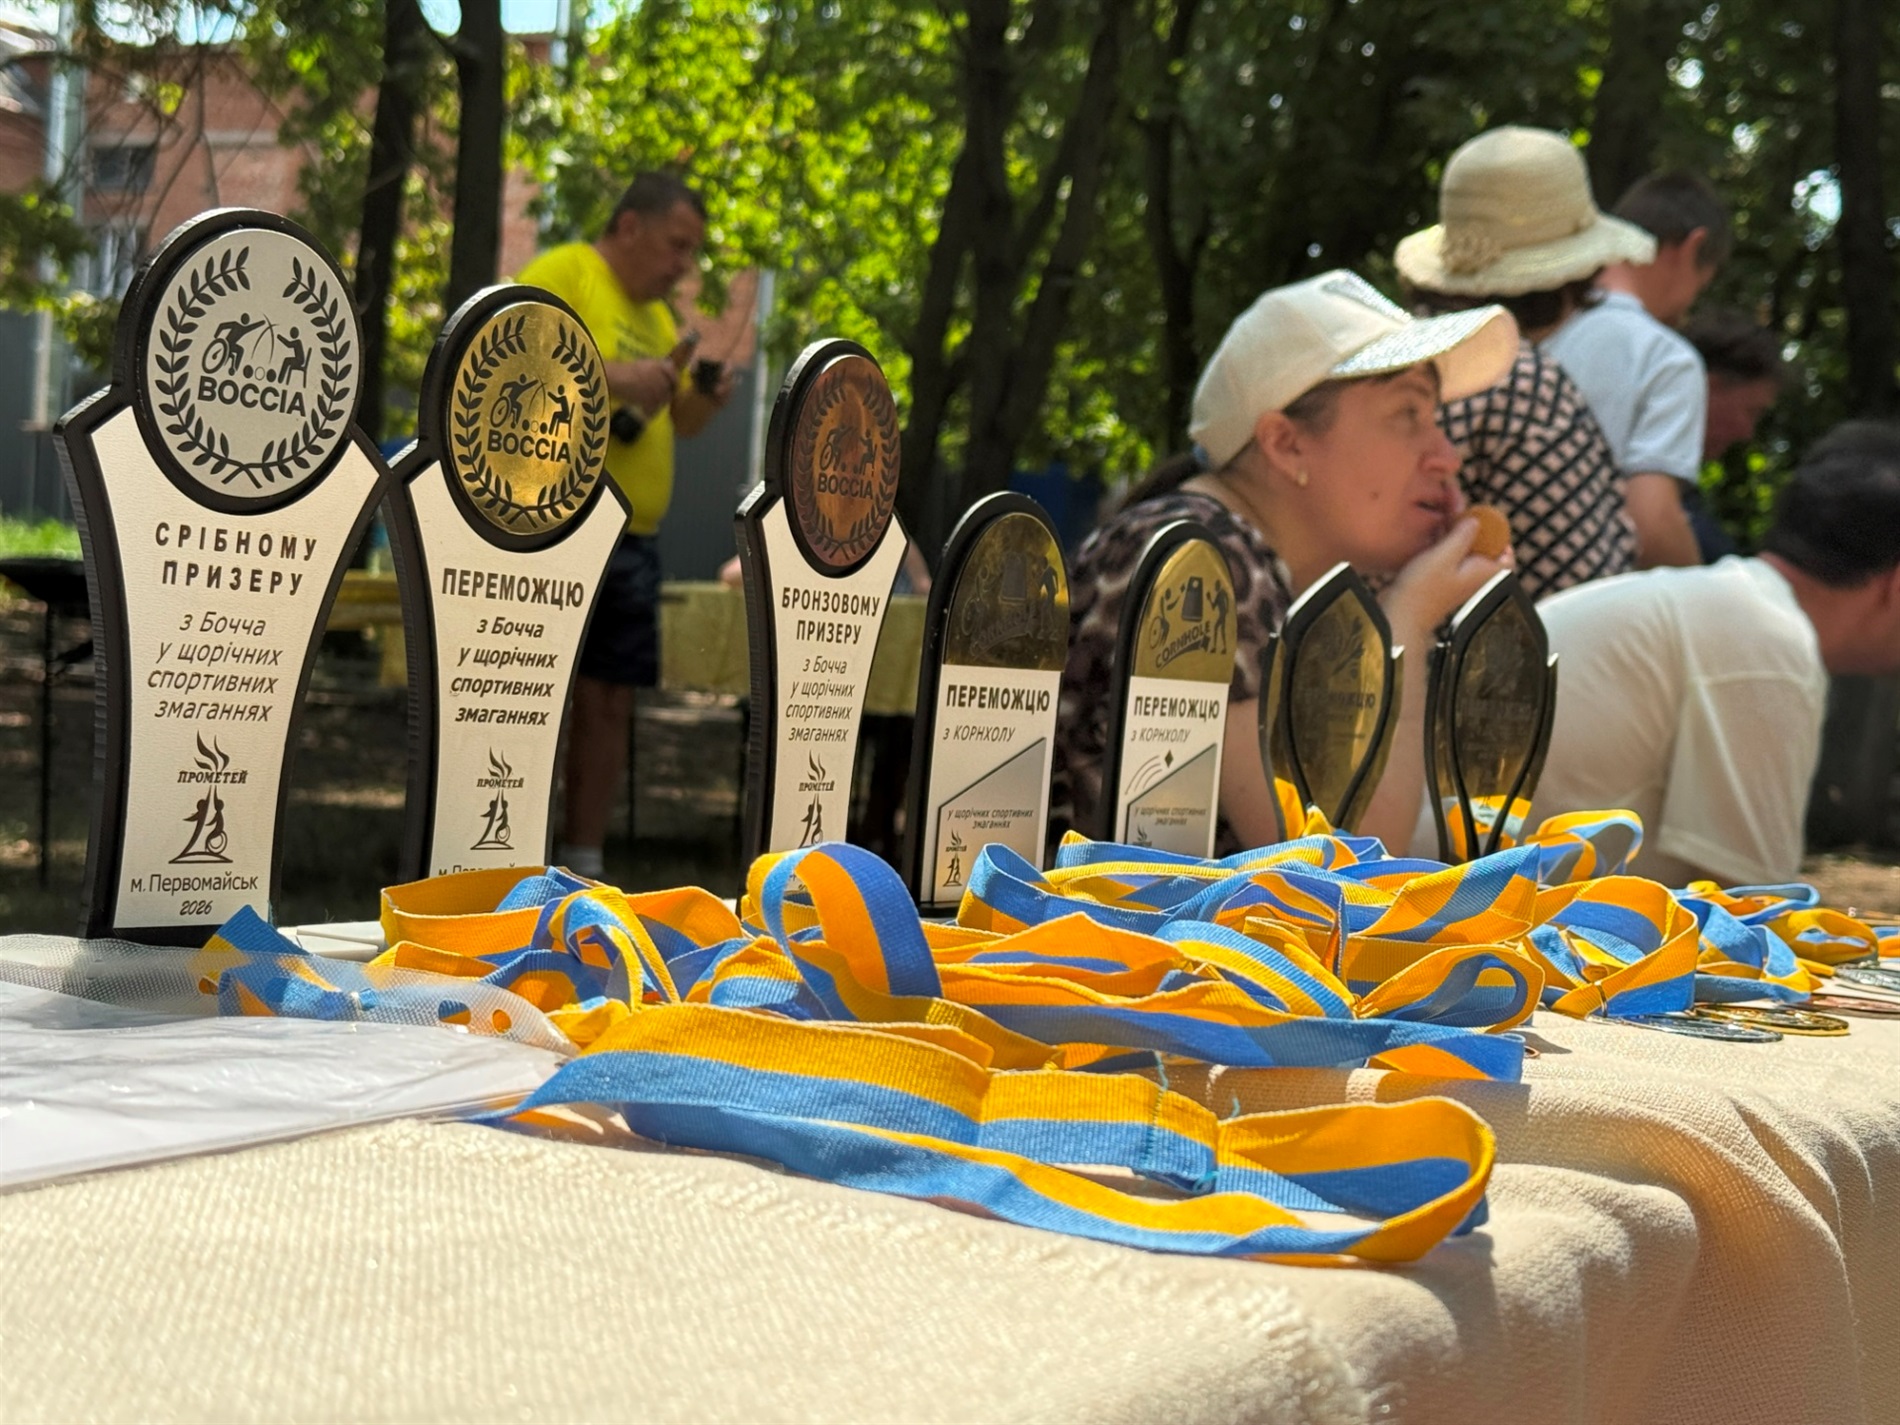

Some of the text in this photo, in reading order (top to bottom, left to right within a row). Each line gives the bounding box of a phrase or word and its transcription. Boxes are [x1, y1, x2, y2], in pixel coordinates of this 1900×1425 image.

[197, 375, 306, 417] BOCCIA
[487, 429, 572, 464] BOCCIA
[817, 472, 874, 500] BOCCIA
[155, 522, 317, 562] СРІБНОМУ
[162, 560, 304, 596] ПРИЗЕРУ
[441, 567, 585, 611] ПЕРЕМОЖЦЮ
[781, 587, 881, 618] БРОНЗОВОМУ
[179, 611, 267, 637] з Бочча
[476, 616, 545, 638] з Бочча
[796, 619, 862, 645] ПРИЗЕРУ
[155, 639, 284, 667] у щорічних
[1155, 620, 1211, 669] CORNHOLE
[456, 646, 558, 670] у щорічних
[802, 655, 848, 675] з Бочча
[147, 669, 279, 695] спортивних
[450, 675, 555, 698] спортивних
[790, 679, 856, 699] у щорічних
[154, 700, 273, 722] змаганнях
[946, 685, 1050, 715] ПЕРЕМОЖЦЮ
[1133, 696, 1220, 722] ПЕРЕМОЖЦЮ
[454, 706, 550, 726] змаганнях
[785, 703, 853, 723] спортивних
[787, 727, 849, 743] змаганнях
[942, 724, 1016, 743] з КОРНХОЛУ
[1139, 727, 1191, 743] КОРНХОЛУ
[177, 769, 249, 785] ПРОМЕТЕЙ
[476, 777, 525, 789] ПРОМЕТЕЙ
[954, 808, 990, 820] щорічних
[991, 809, 1034, 820] спортивних
[130, 871, 259, 896] м. Первомайськ
[179, 899, 213, 916] 2026
